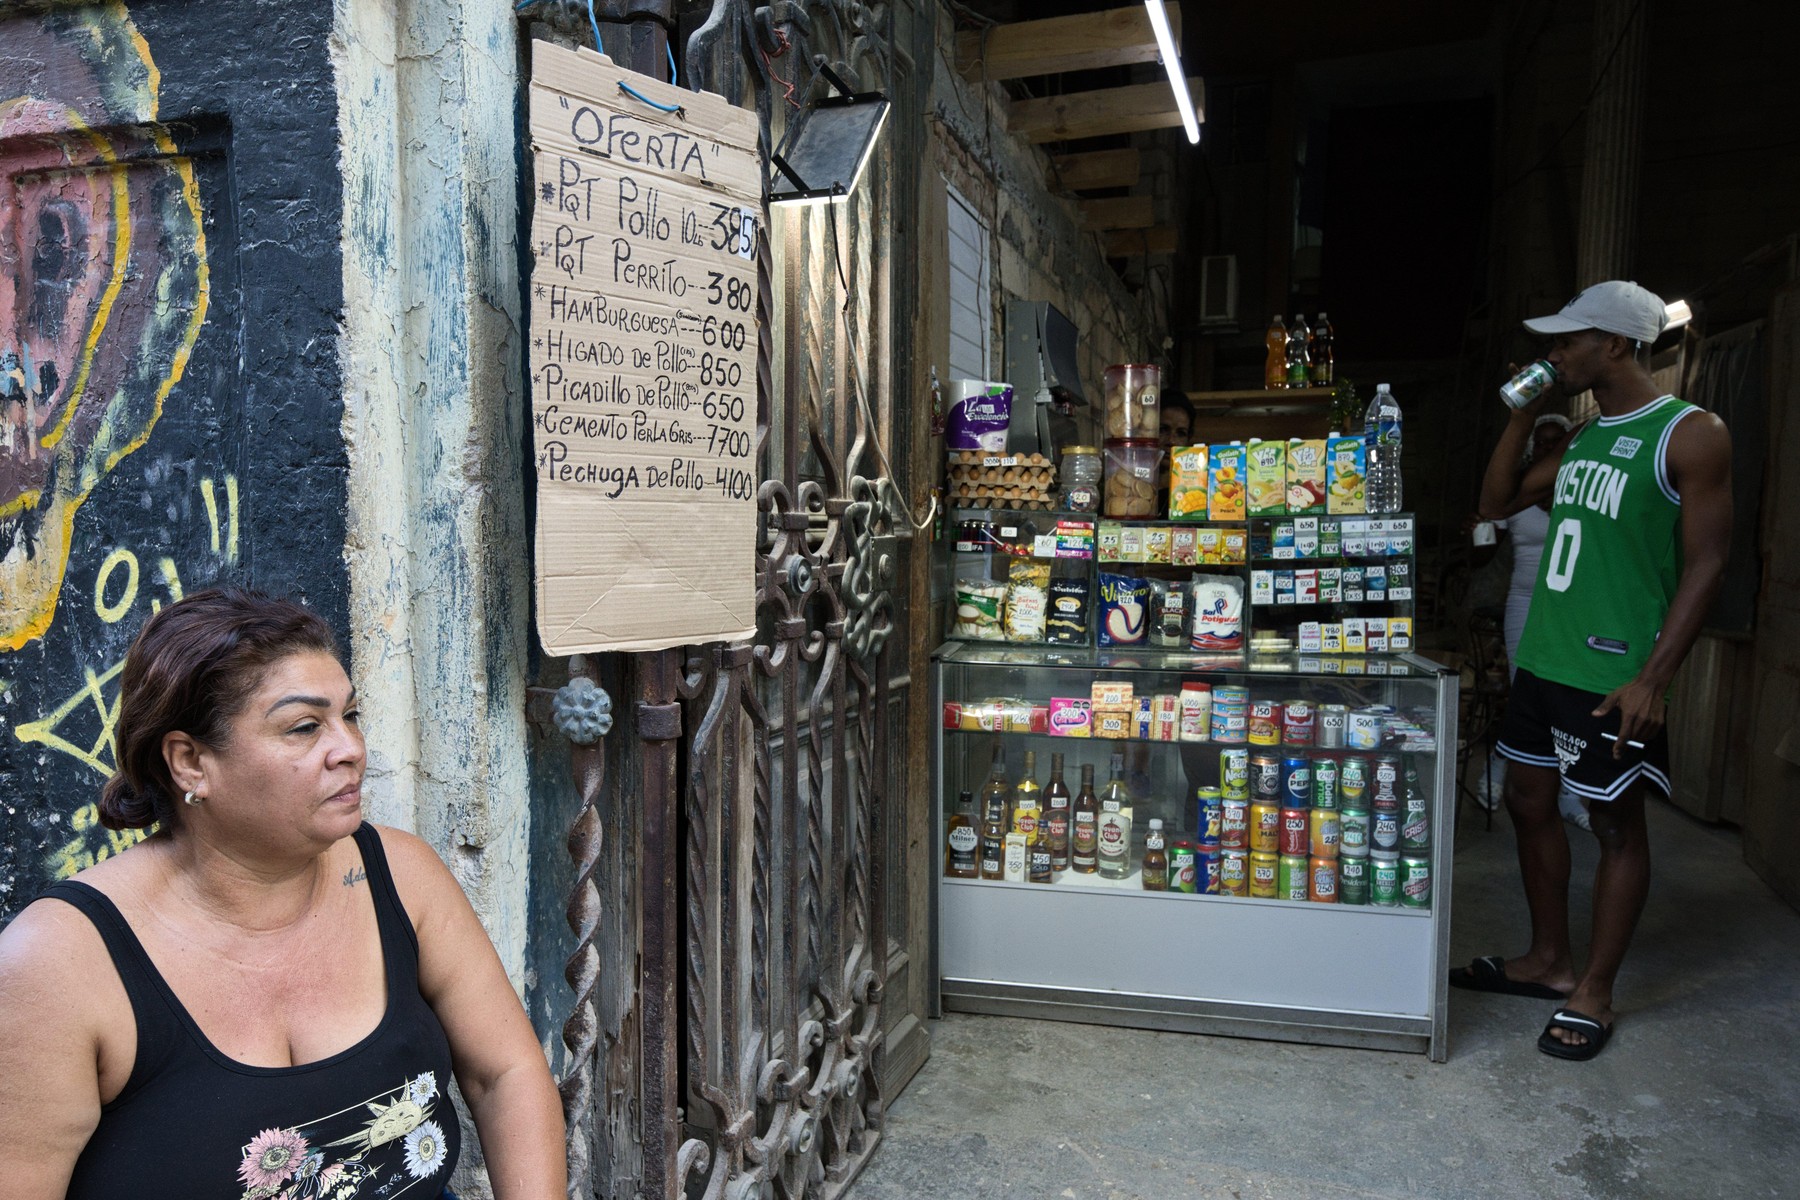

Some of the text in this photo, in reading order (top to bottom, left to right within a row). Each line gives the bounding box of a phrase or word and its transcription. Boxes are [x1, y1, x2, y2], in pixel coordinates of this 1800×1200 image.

[619, 176, 670, 241] Pollo
[707, 270, 751, 312] 380
[702, 315, 746, 351] 600
[548, 329, 624, 366] HIGADO
[654, 340, 687, 374] Pollo
[701, 351, 742, 387] 850
[654, 375, 690, 412] Pollo
[703, 391, 745, 423] 650
[1144, 395, 1153, 403] 60
[707, 424, 750, 458] 7700
[1618, 438, 1639, 449] VISTA
[1612, 446, 1635, 457] PRINT
[1261, 457, 1274, 467] 870
[669, 457, 704, 491] Pollo
[715, 467, 753, 501] 4100
[1300, 521, 1314, 529] 650
[1369, 522, 1383, 530] 650
[1393, 521, 1408, 529] 650
[1104, 536, 1116, 544] 25
[1152, 532, 1165, 541] 25
[1178, 533, 1190, 543] 25
[1546, 518, 1581, 592] 0
[1104, 720, 1120, 729] 300
[1326, 717, 1343, 727] 650
[1356, 719, 1373, 728] 500
[1551, 726, 1587, 749] CHICAGO
[1286, 820, 1303, 829] 250
[1377, 820, 1395, 832] 240
[1103, 831, 1119, 841] Club
[1378, 871, 1395, 880] 240
